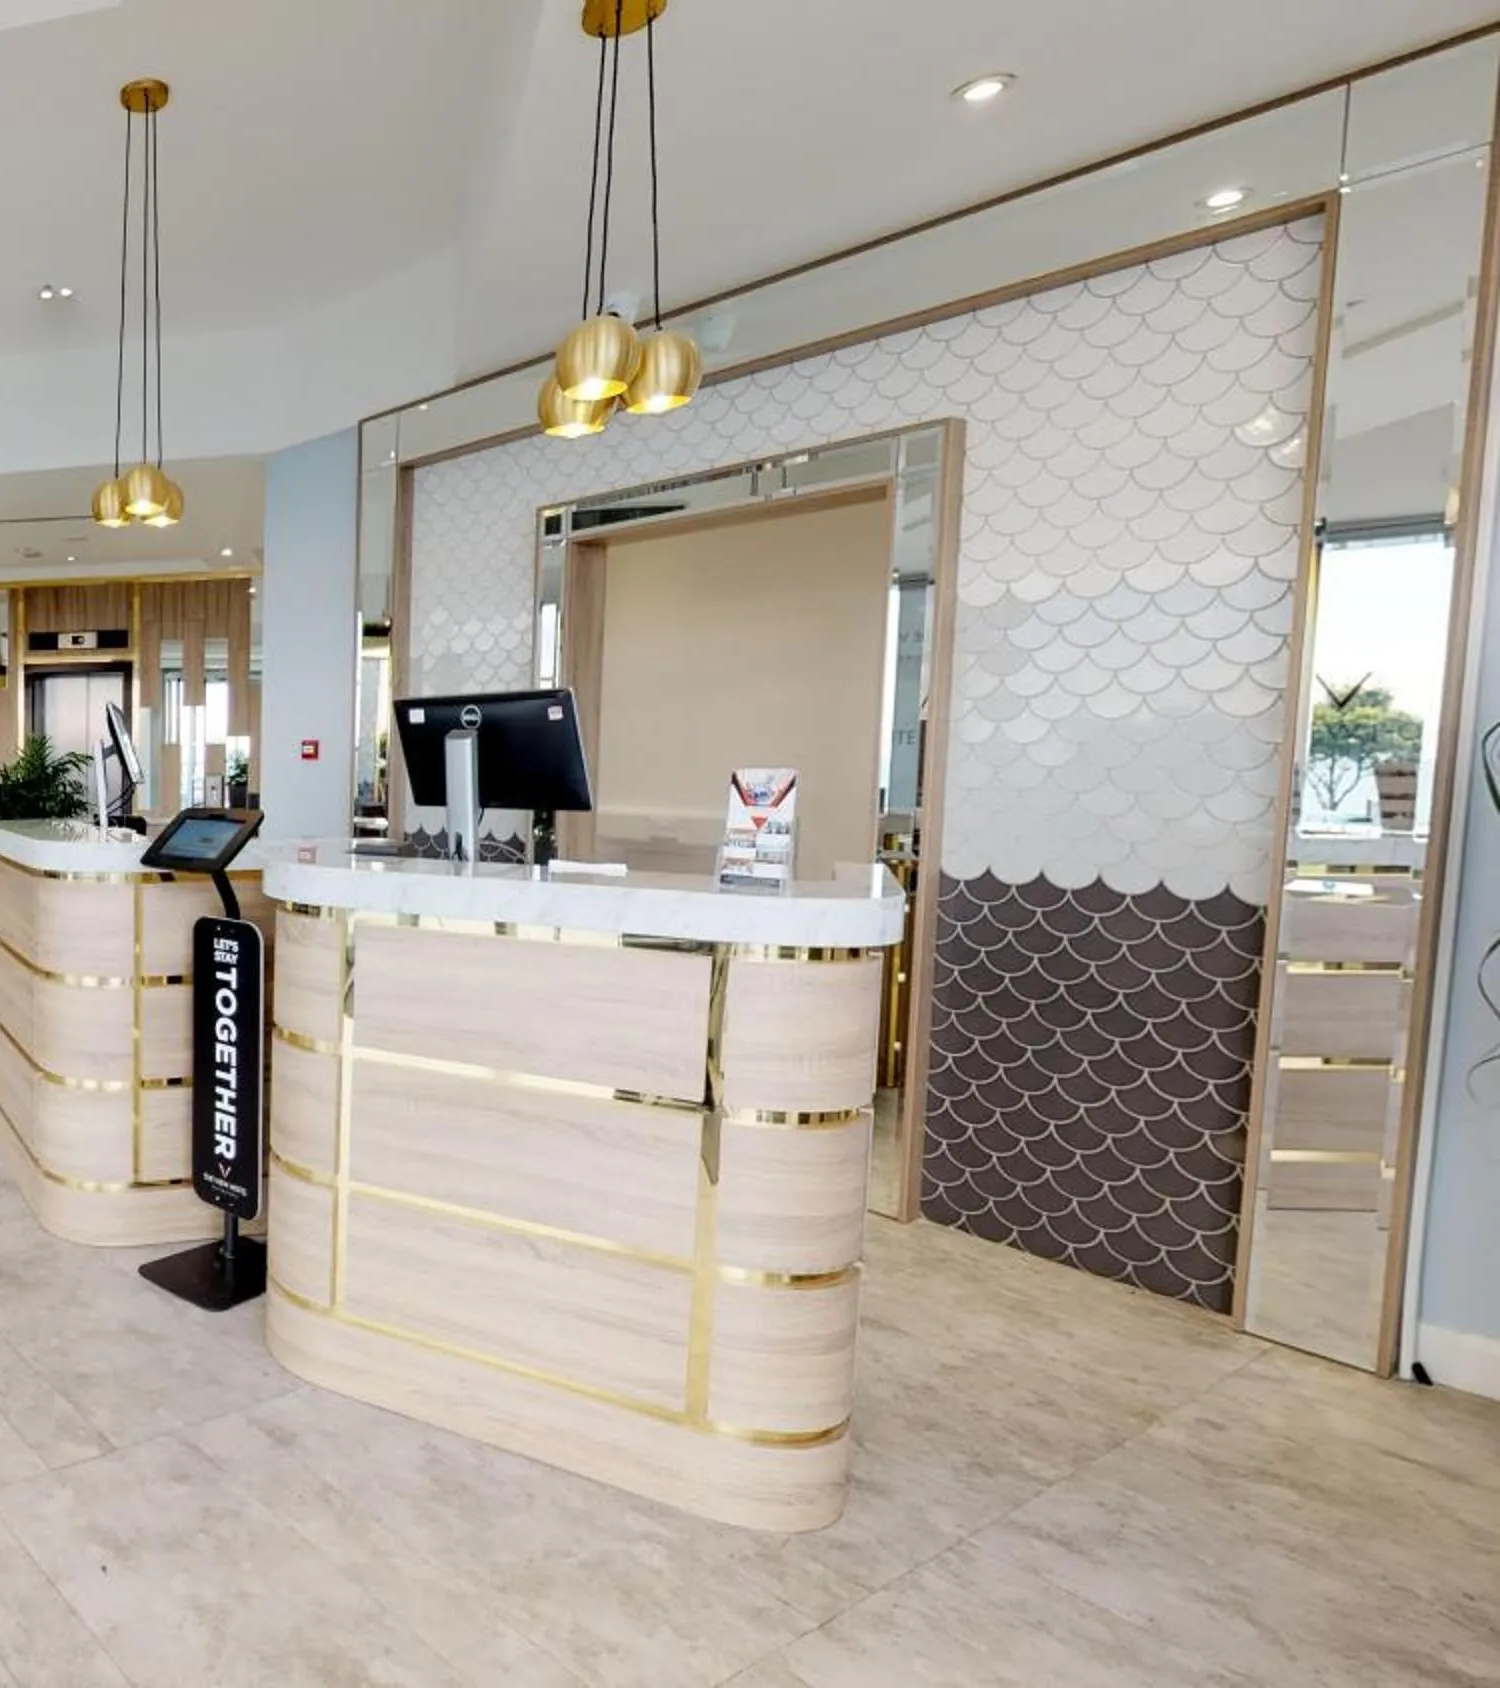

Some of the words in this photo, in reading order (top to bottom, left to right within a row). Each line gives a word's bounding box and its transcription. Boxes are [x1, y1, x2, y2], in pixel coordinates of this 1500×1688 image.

[213, 937, 239, 953] LET'S
[213, 950, 239, 965] STAY
[214, 966, 238, 1161] TOGETHER
